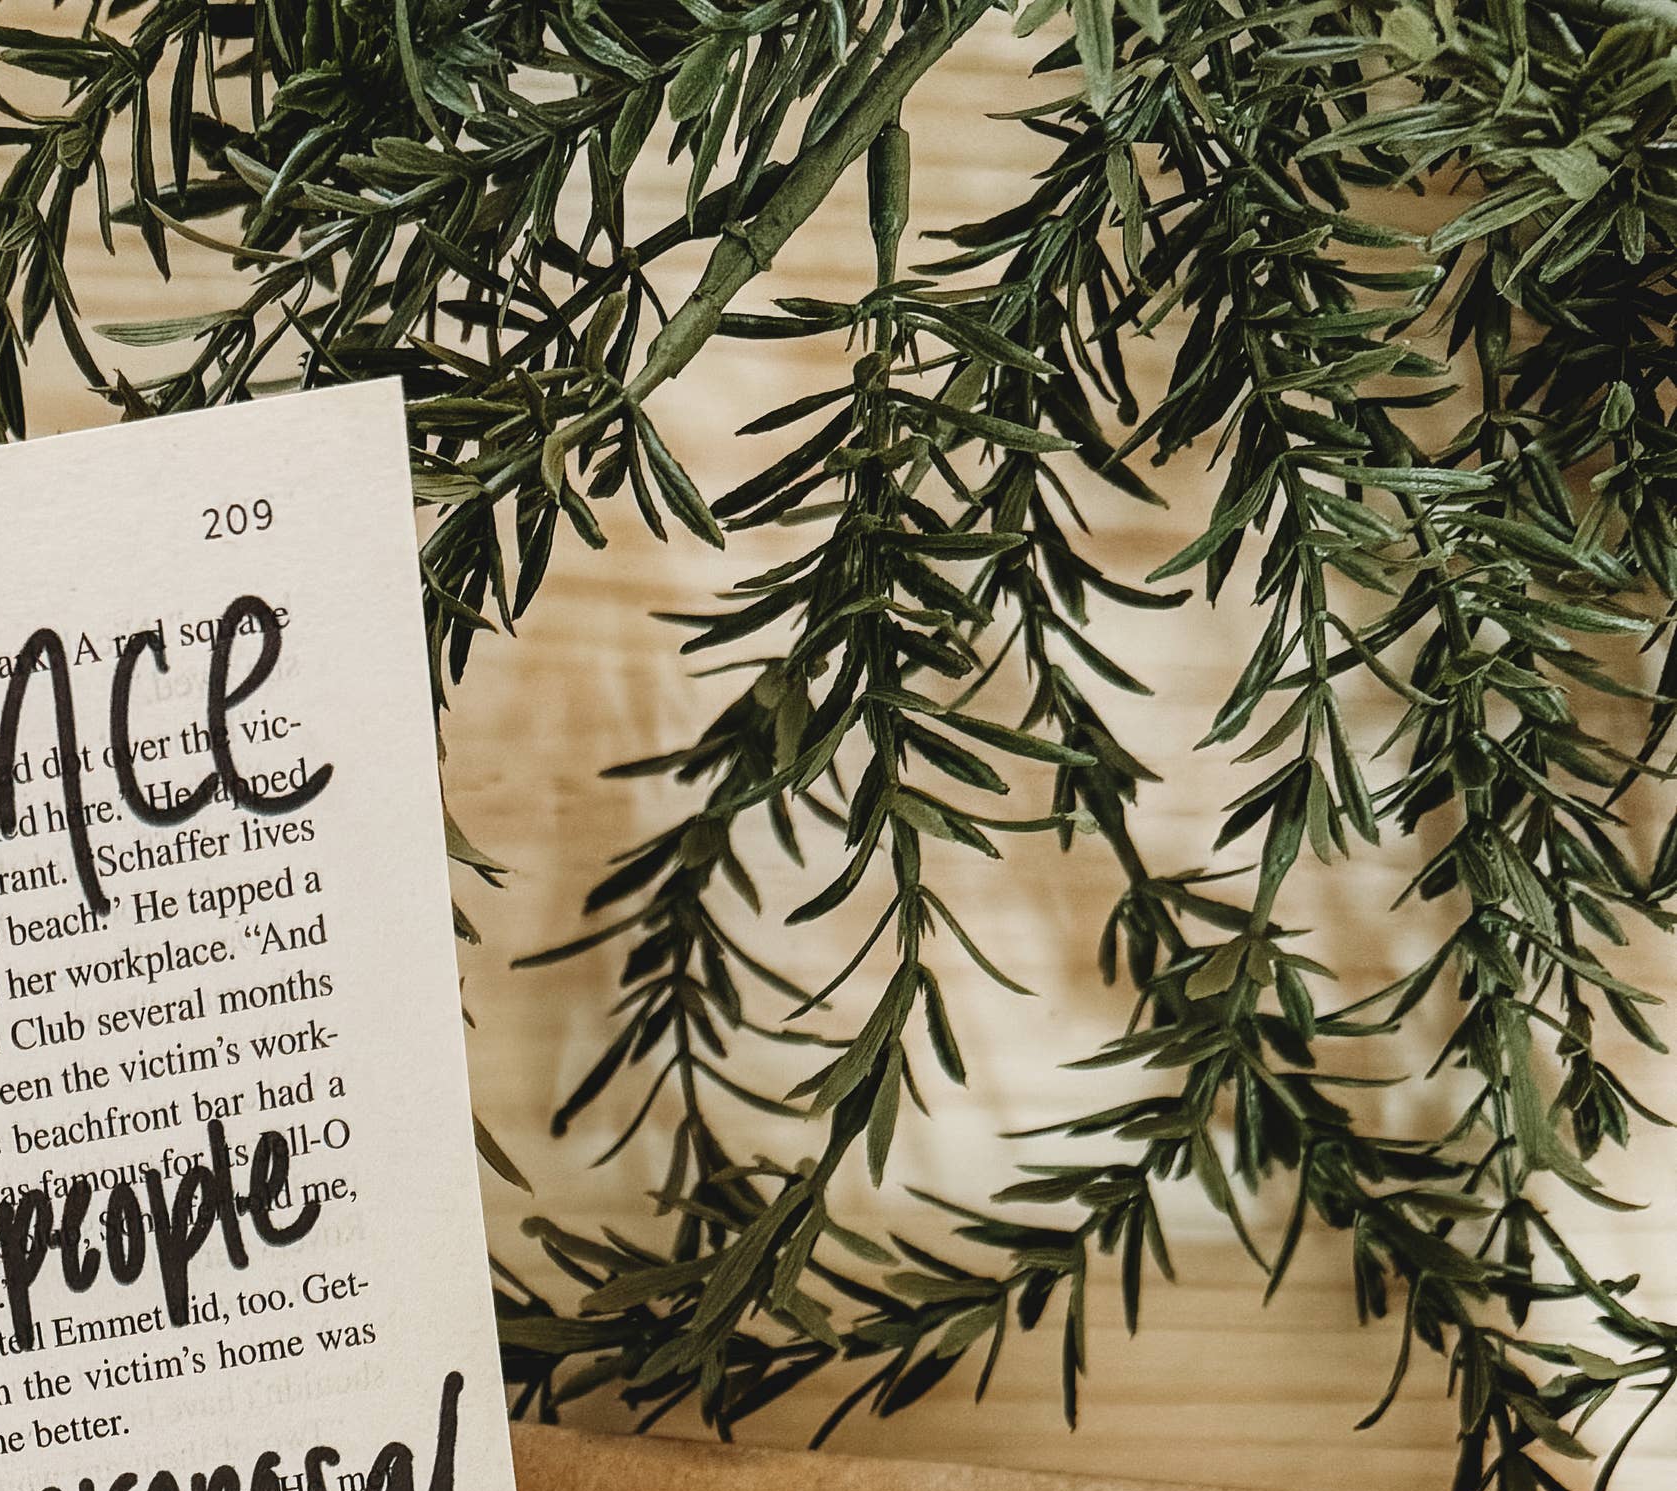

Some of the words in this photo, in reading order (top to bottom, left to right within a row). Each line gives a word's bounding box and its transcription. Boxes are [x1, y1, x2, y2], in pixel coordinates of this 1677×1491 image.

[201, 496, 275, 541] 209
[239, 708, 302, 746] vic-
[239, 818, 316, 854] lives
[130, 891, 179, 926] He
[186, 867, 295, 920] tapped
[6, 966, 59, 1000] her
[65, 940, 236, 990] workplace.
[8, 1008, 87, 1052] Club
[96, 987, 206, 1037] several
[216, 967, 334, 1016] months
[60, 1060, 110, 1095] the
[249, 1019, 339, 1063] work-
[12, 1099, 182, 1154] beachfront
[192, 1089, 246, 1123] bar
[254, 1072, 315, 1112] had
[158, 1148, 206, 1180] for
[301, 1176, 358, 1205] me,
[0, 1118, 322, 1354] people
[51, 1303, 166, 1347] Emmet
[236, 1287, 294, 1316] too.
[300, 1270, 370, 1305] Get-
[22, 1367, 73, 1400] the
[215, 1334, 305, 1369] home
[315, 1322, 377, 1352] was
[32, 1414, 130, 1448] better.
